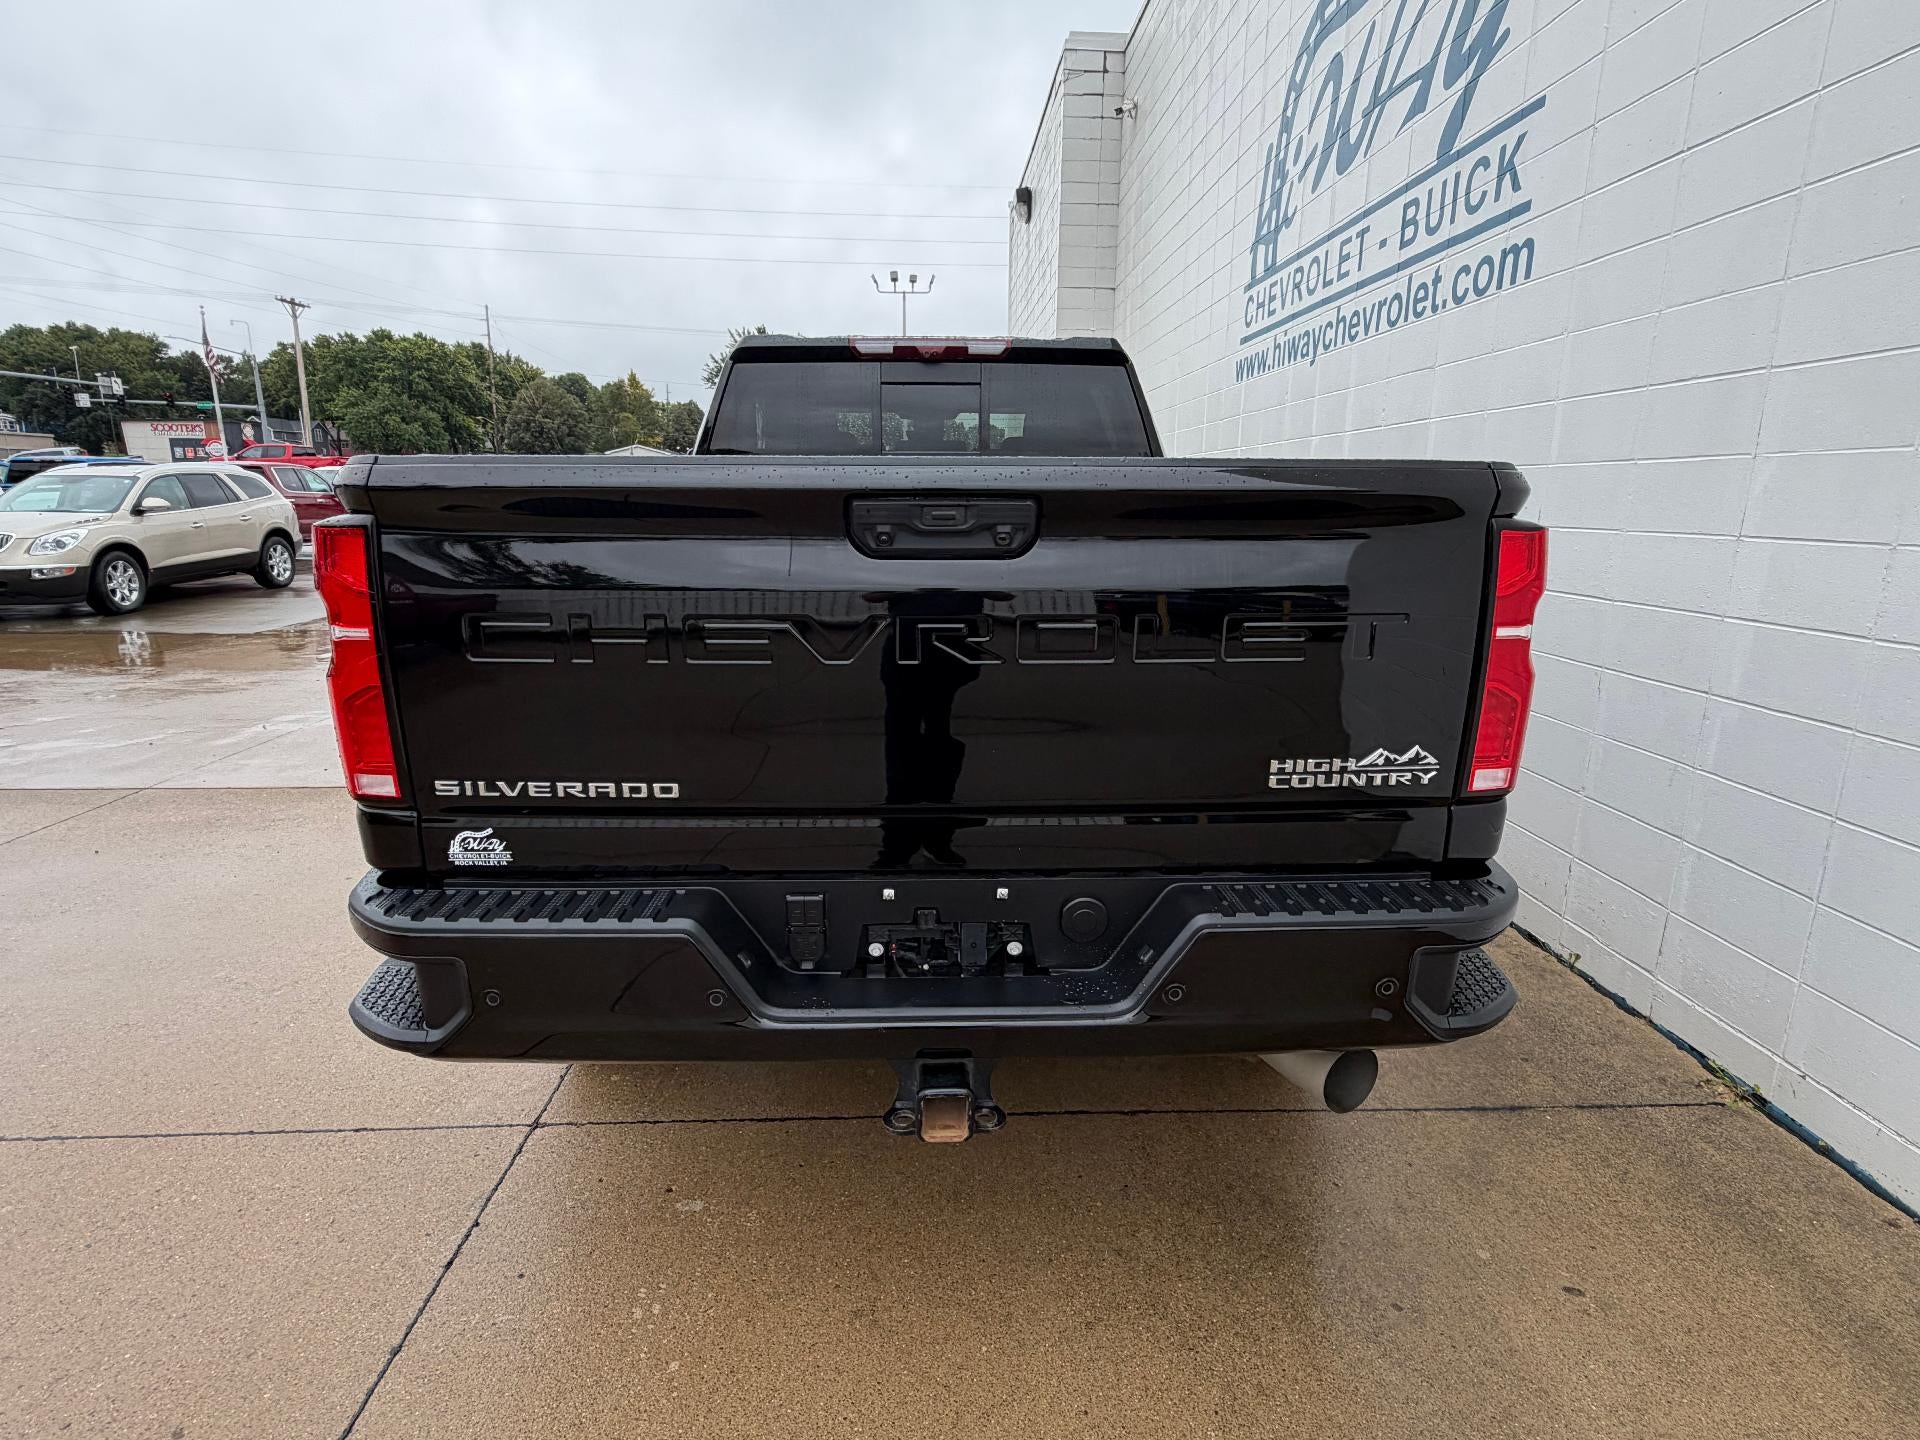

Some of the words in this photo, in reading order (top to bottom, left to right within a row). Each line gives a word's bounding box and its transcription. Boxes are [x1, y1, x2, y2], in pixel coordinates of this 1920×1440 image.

[1244, 226, 1371, 329] CHEVROLET
[1399, 130, 1529, 251] BUICK
[1235, 237, 1535, 383] www.hiwaychevrolet.com
[151, 423, 204, 432] SCOOTER'S
[462, 612, 1411, 664] CHEVROLET
[1269, 758, 1357, 773] HIGH
[434, 780, 680, 799] SILVERADO
[1268, 771, 1438, 789] COUNTRY
